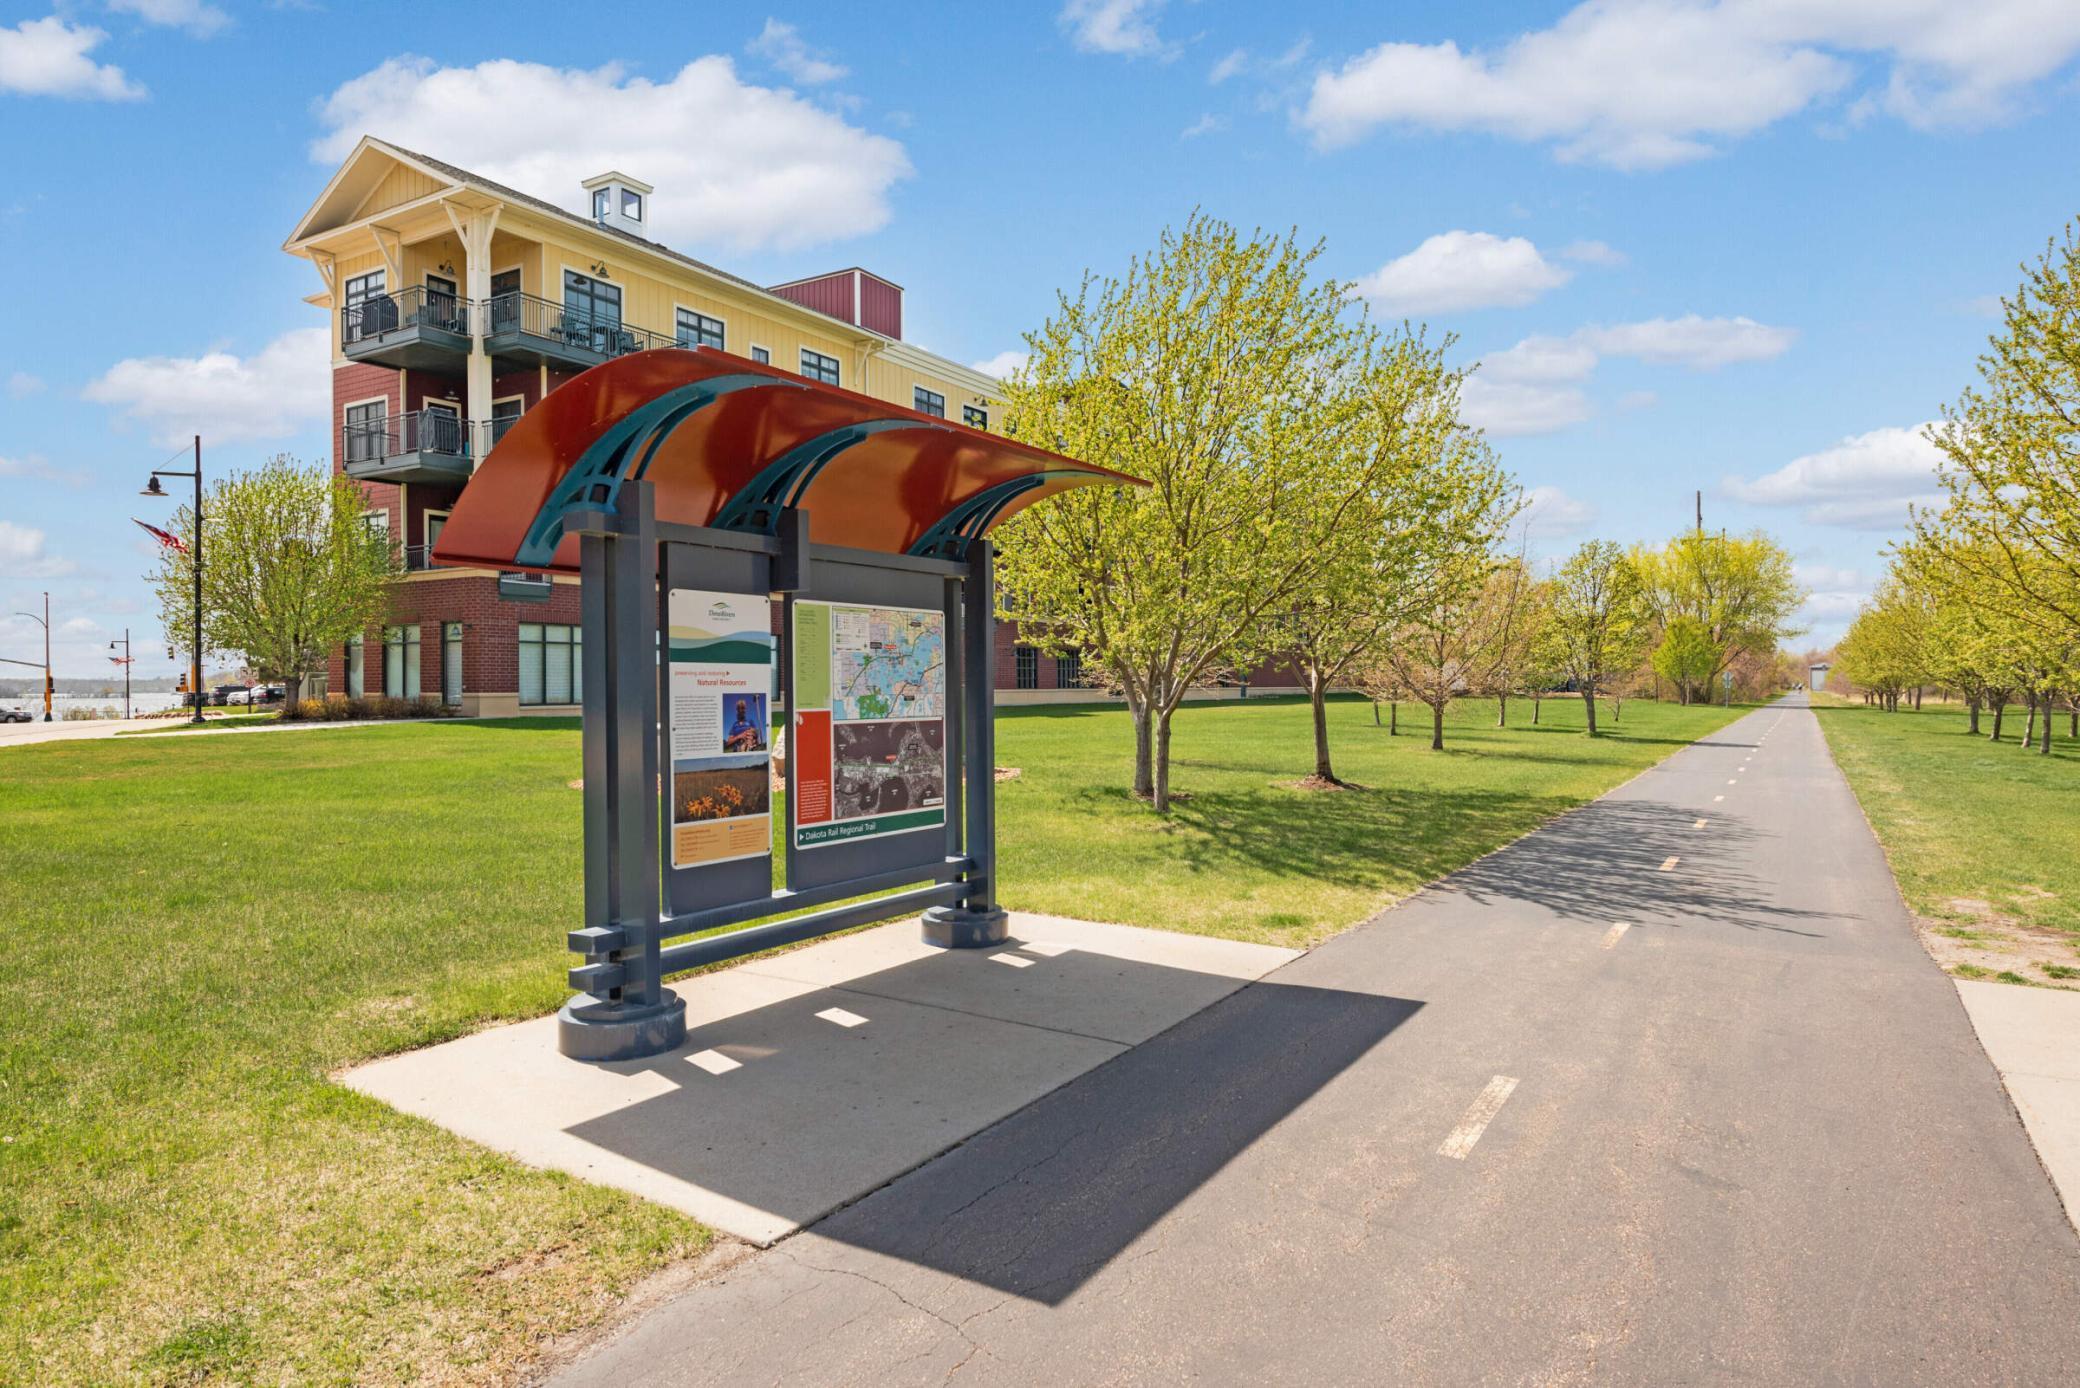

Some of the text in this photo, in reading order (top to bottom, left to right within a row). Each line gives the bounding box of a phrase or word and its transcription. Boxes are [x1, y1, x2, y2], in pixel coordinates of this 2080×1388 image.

[805, 822, 876, 840] Dakota Rail Regional Trail
